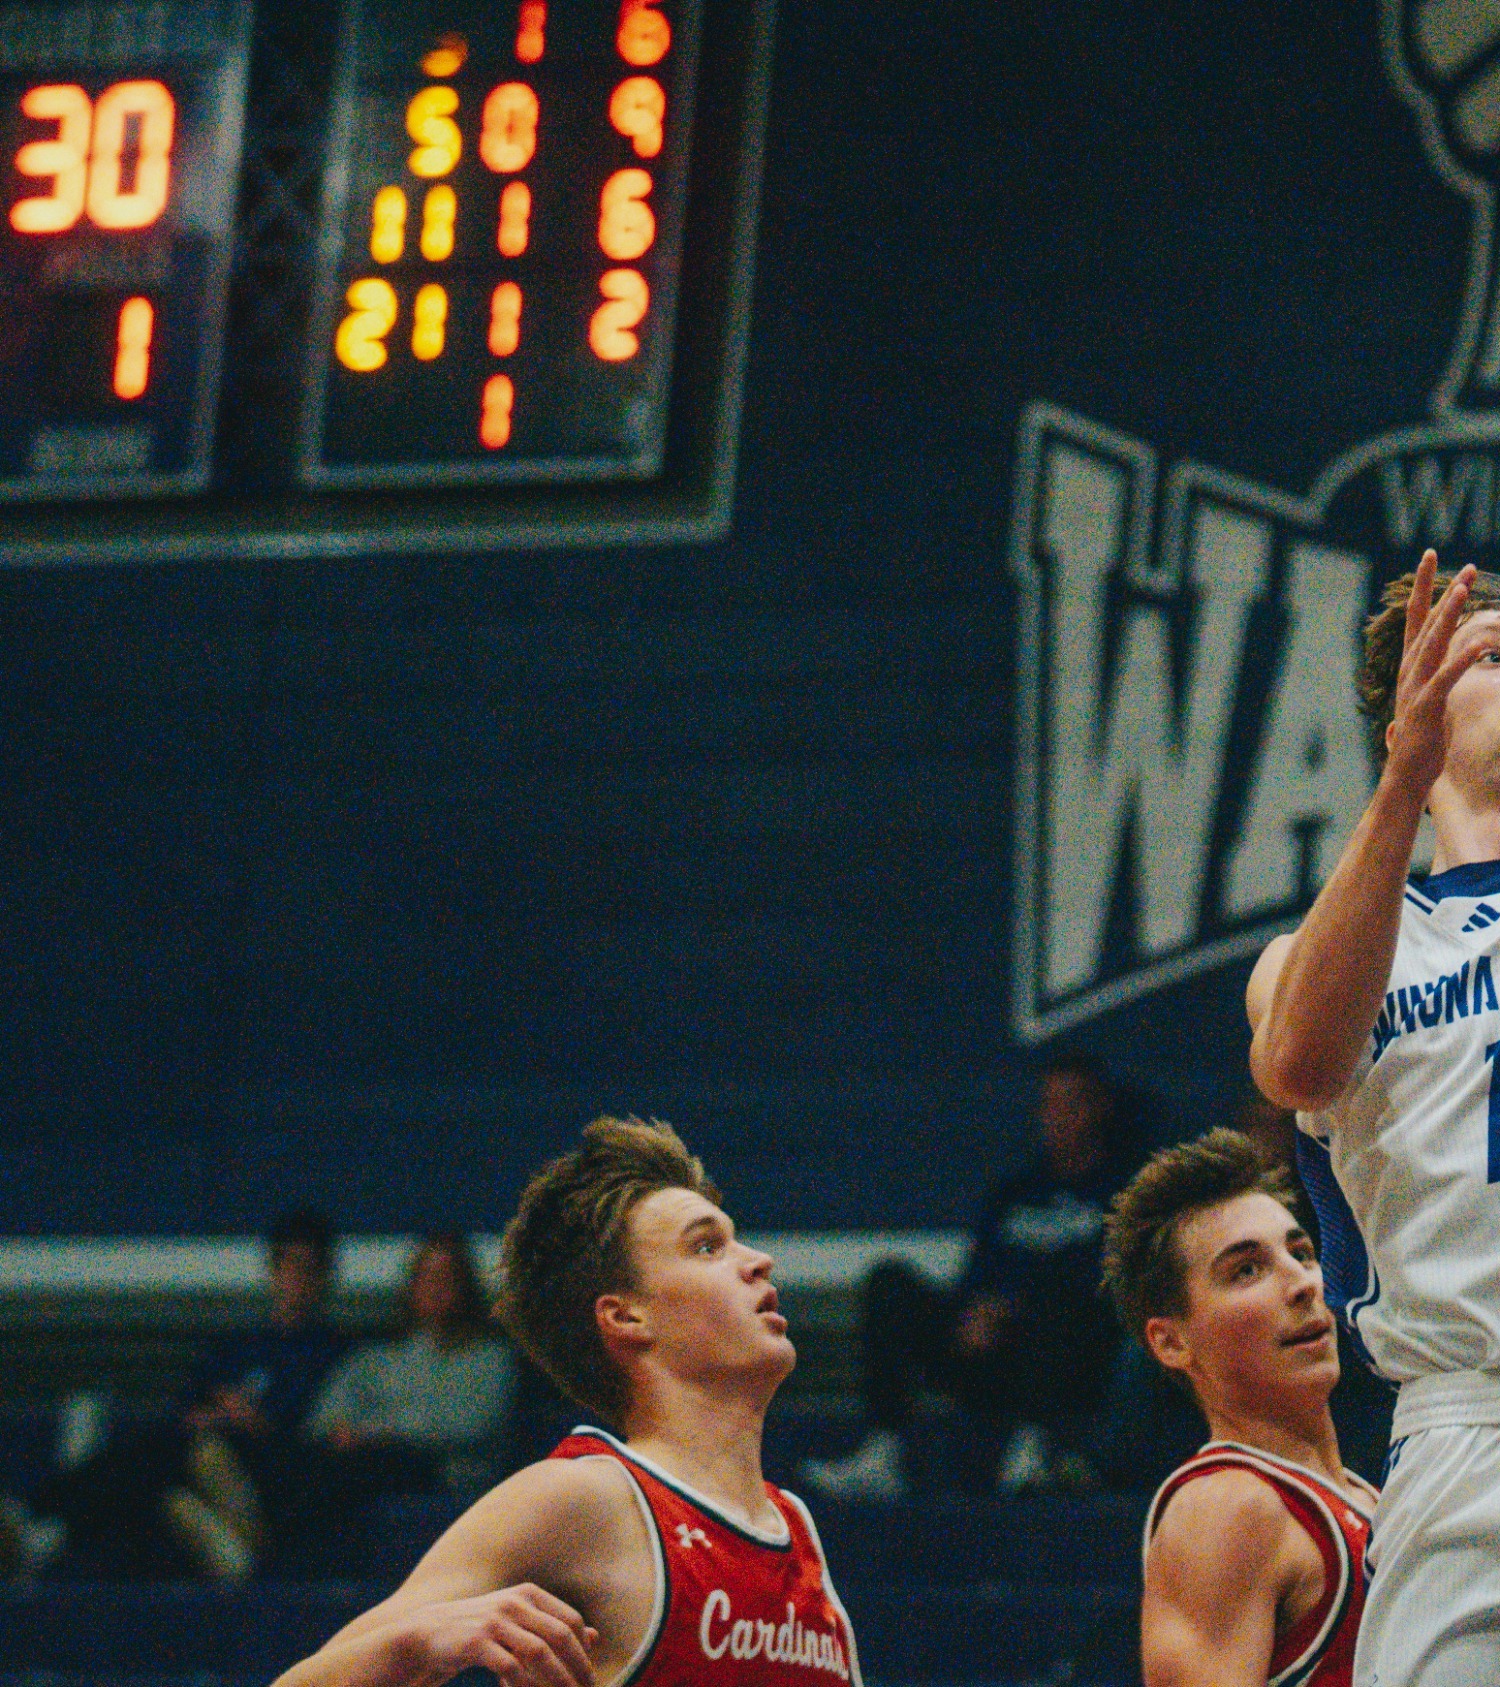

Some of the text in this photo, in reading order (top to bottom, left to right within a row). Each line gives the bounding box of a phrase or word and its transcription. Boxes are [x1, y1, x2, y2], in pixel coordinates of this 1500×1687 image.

[9, 79, 175, 235] 30
[406, 76, 666, 178] 5 0 9
[370, 168, 656, 264] 11 1 6
[114, 297, 154, 399] 1
[336, 267, 650, 372] 21 1 2
[480, 374, 514, 448] 1
